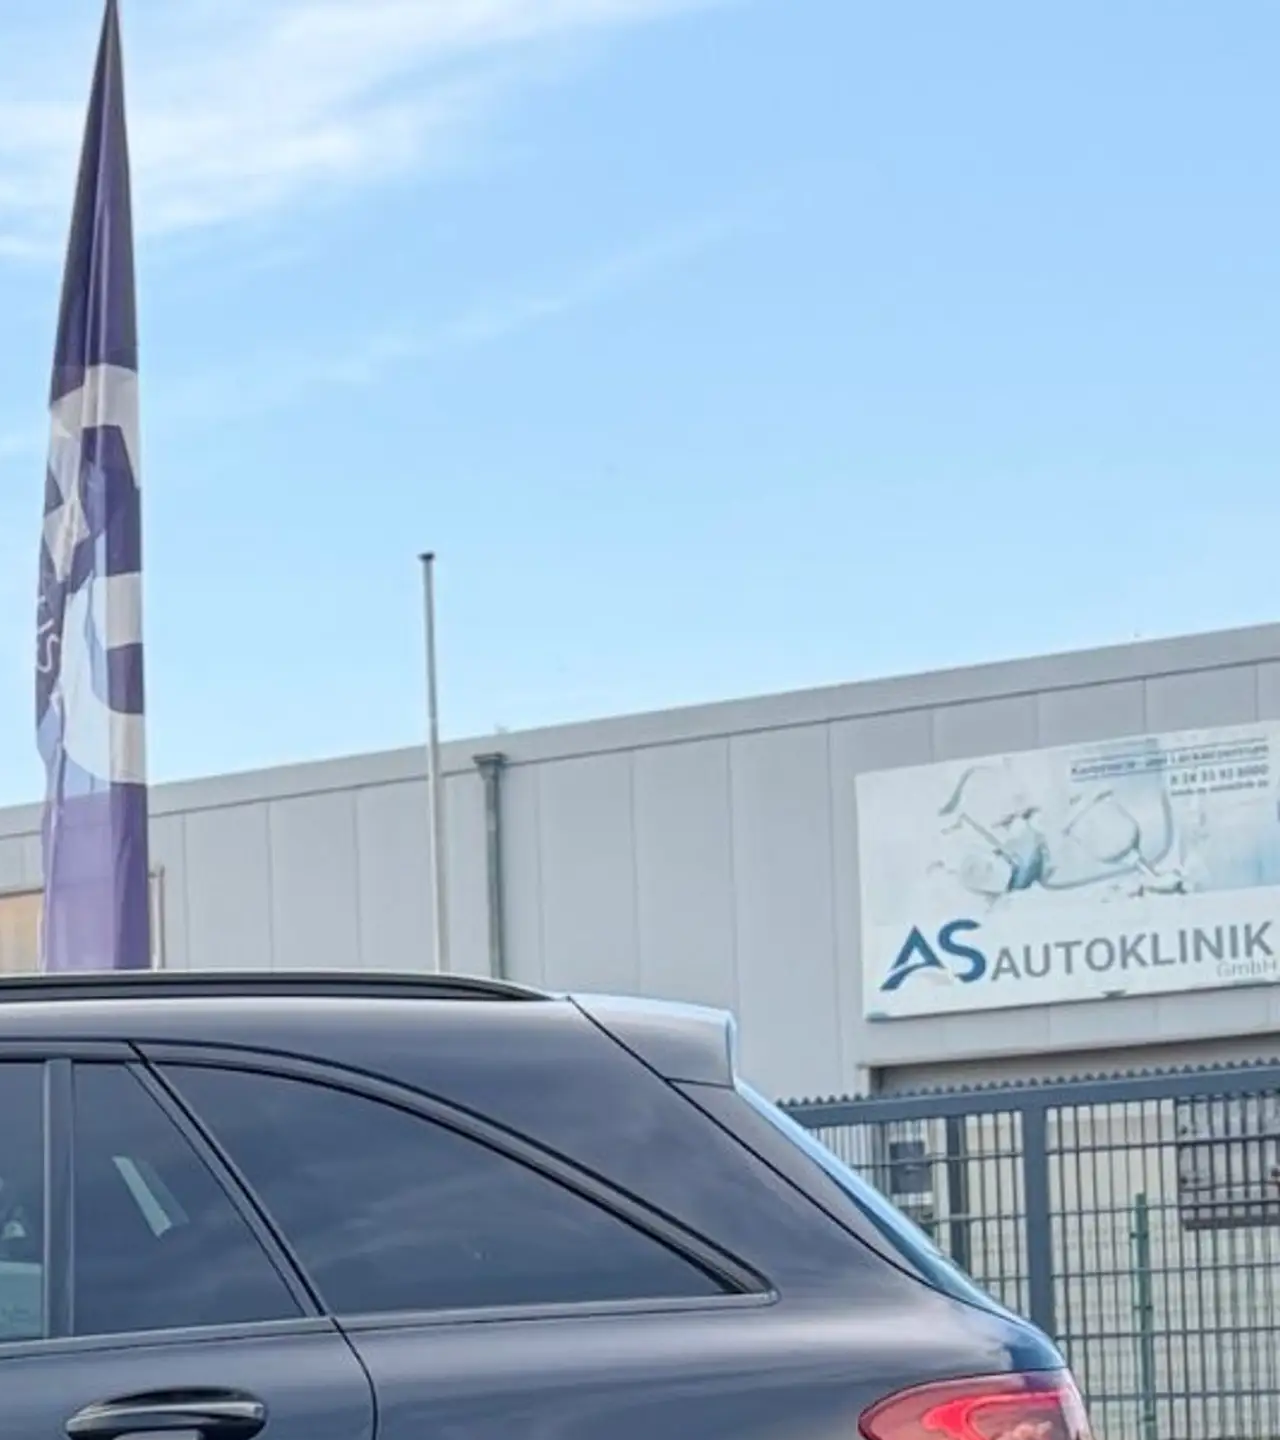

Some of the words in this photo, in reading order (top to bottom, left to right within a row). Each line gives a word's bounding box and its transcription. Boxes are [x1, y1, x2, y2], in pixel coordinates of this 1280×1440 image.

[880, 918, 987, 991] AS
[990, 920, 1275, 982] AUTOKLINIK
[1216, 960, 1278, 979] GmbH
